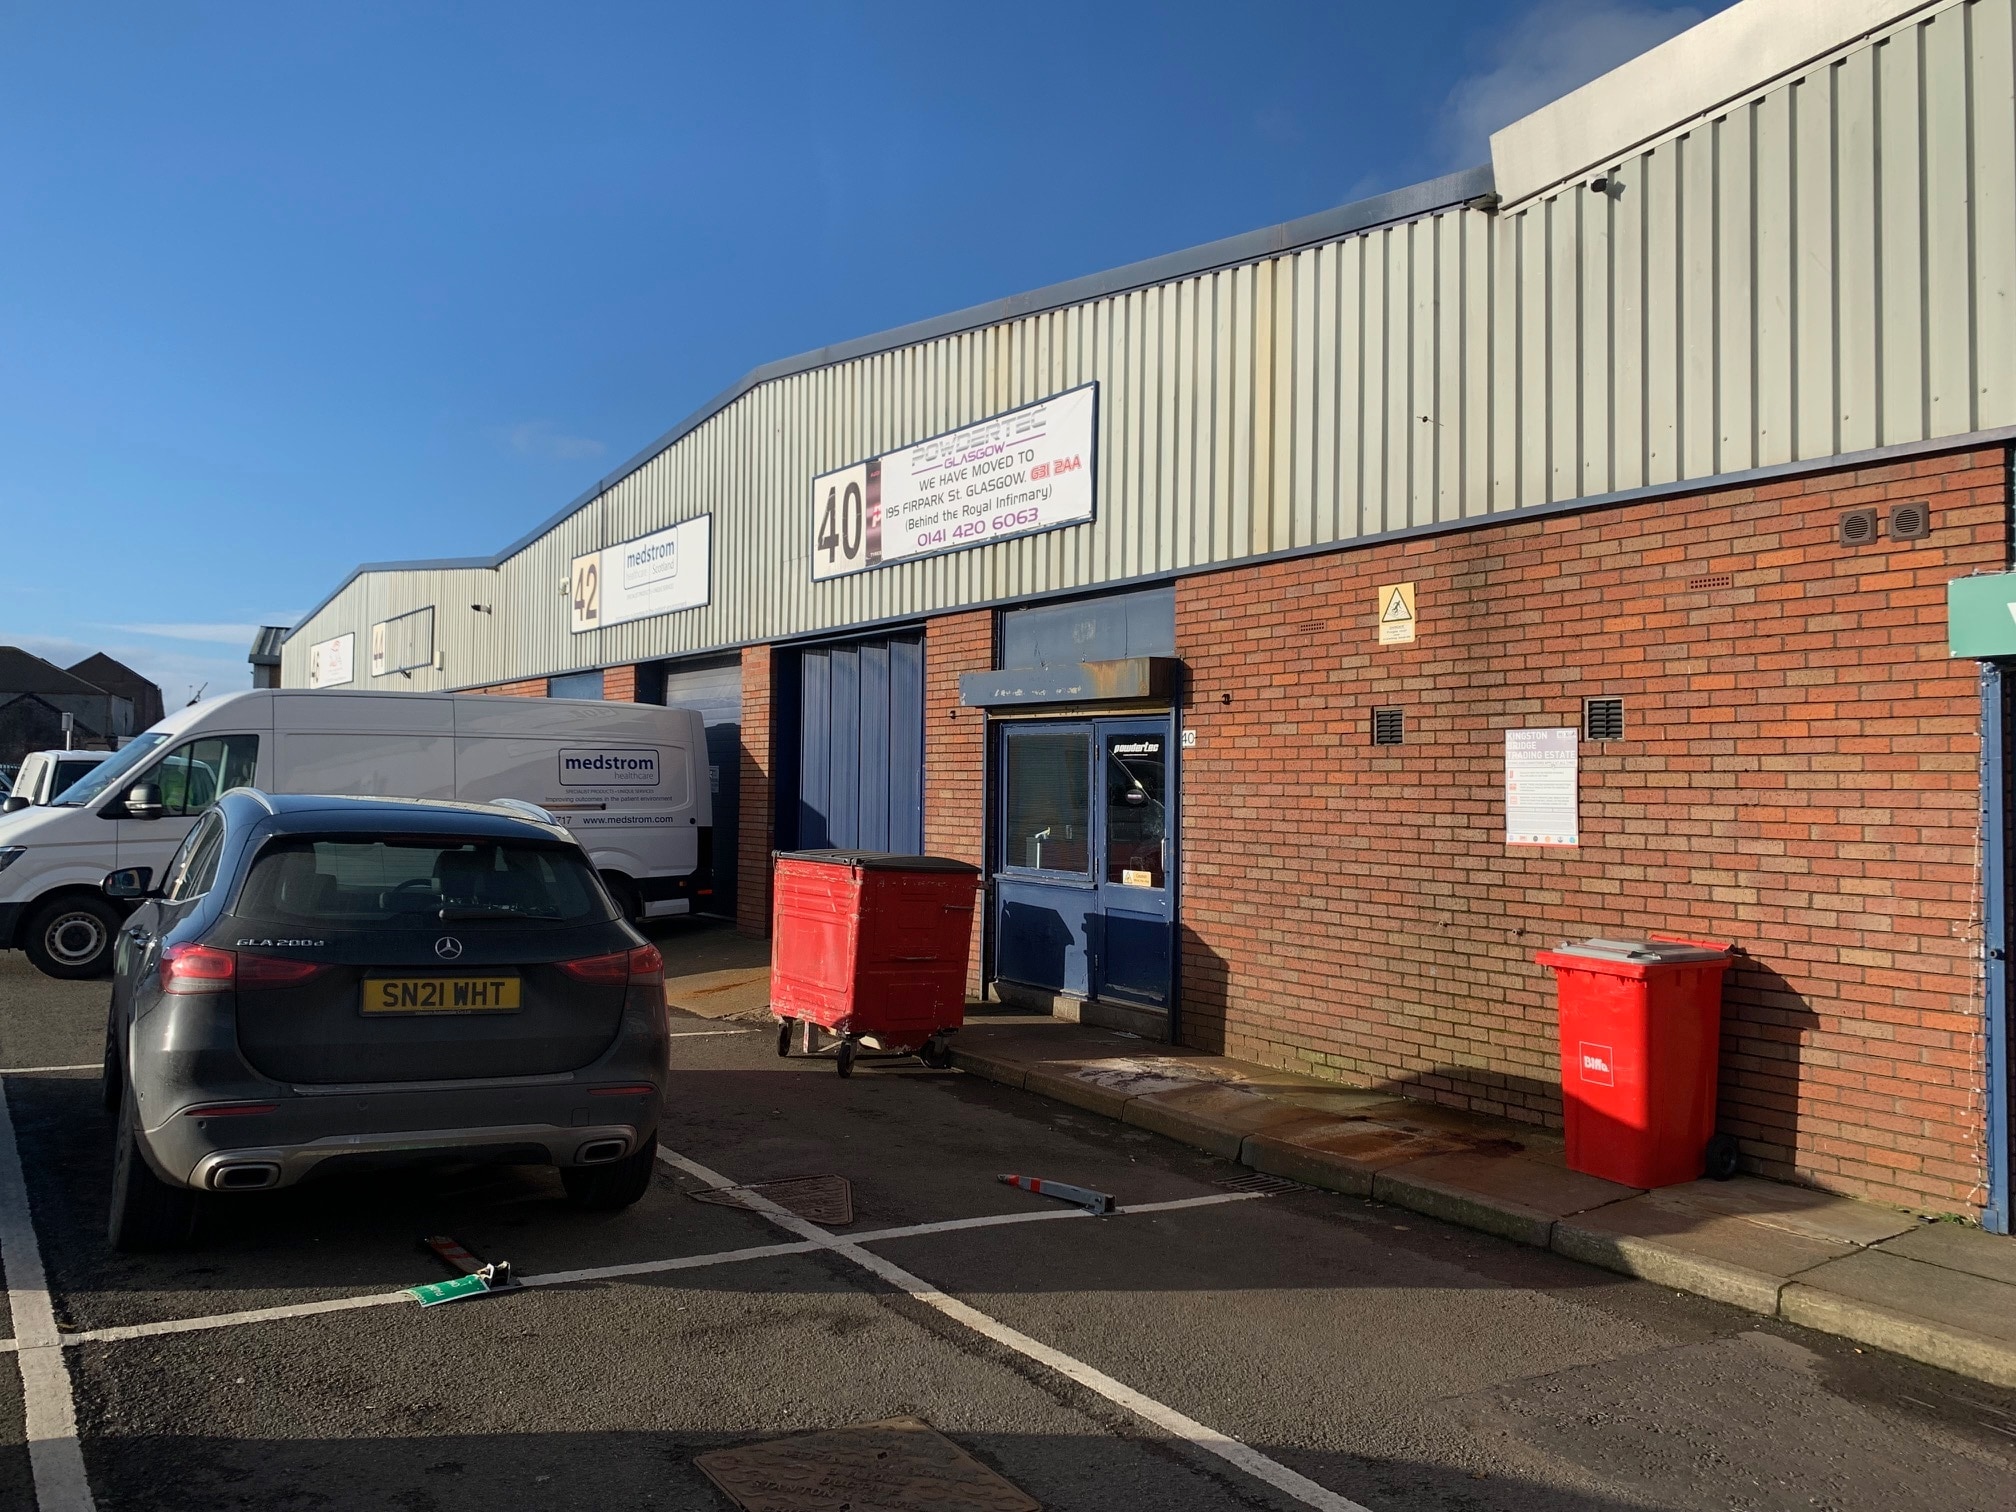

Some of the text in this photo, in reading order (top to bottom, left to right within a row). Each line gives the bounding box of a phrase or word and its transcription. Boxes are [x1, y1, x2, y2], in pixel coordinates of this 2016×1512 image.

[912, 407, 1047, 466] POWDERTEC
[944, 442, 1005, 469] GLASGOW
[919, 449, 1034, 491] WE HAVE MOVED TO
[886, 505, 900, 519] 195
[902, 493, 944, 514] FIRPARK
[948, 490, 962, 502] St.
[966, 471, 1026, 497] GLASGOW.
[1053, 454, 1082, 474] 2AA
[905, 512, 939, 532] (Behind
[943, 508, 958, 520] the
[962, 499, 992, 518] Royal
[996, 484, 1052, 509] Infirmary)
[817, 482, 862, 563] 40
[917, 507, 1039, 547] 0141 420 6063
[627, 541, 675, 569] medstrom
[574, 563, 597, 621] 42
[374, 630, 384, 669] 44
[1182, 732, 1195, 744] 40
[1507, 731, 1548, 740] KINGSTON
[1507, 741, 1537, 750] BRIDGE
[565, 754, 654, 770] medstrom
[1507, 750, 1576, 759] TRADING ESTATE
[614, 771, 654, 780] healthcare
[582, 815, 674, 825] www.medstrom.com
[236, 938, 274, 947] GLA
[382, 981, 505, 1007] SN21 WHT
